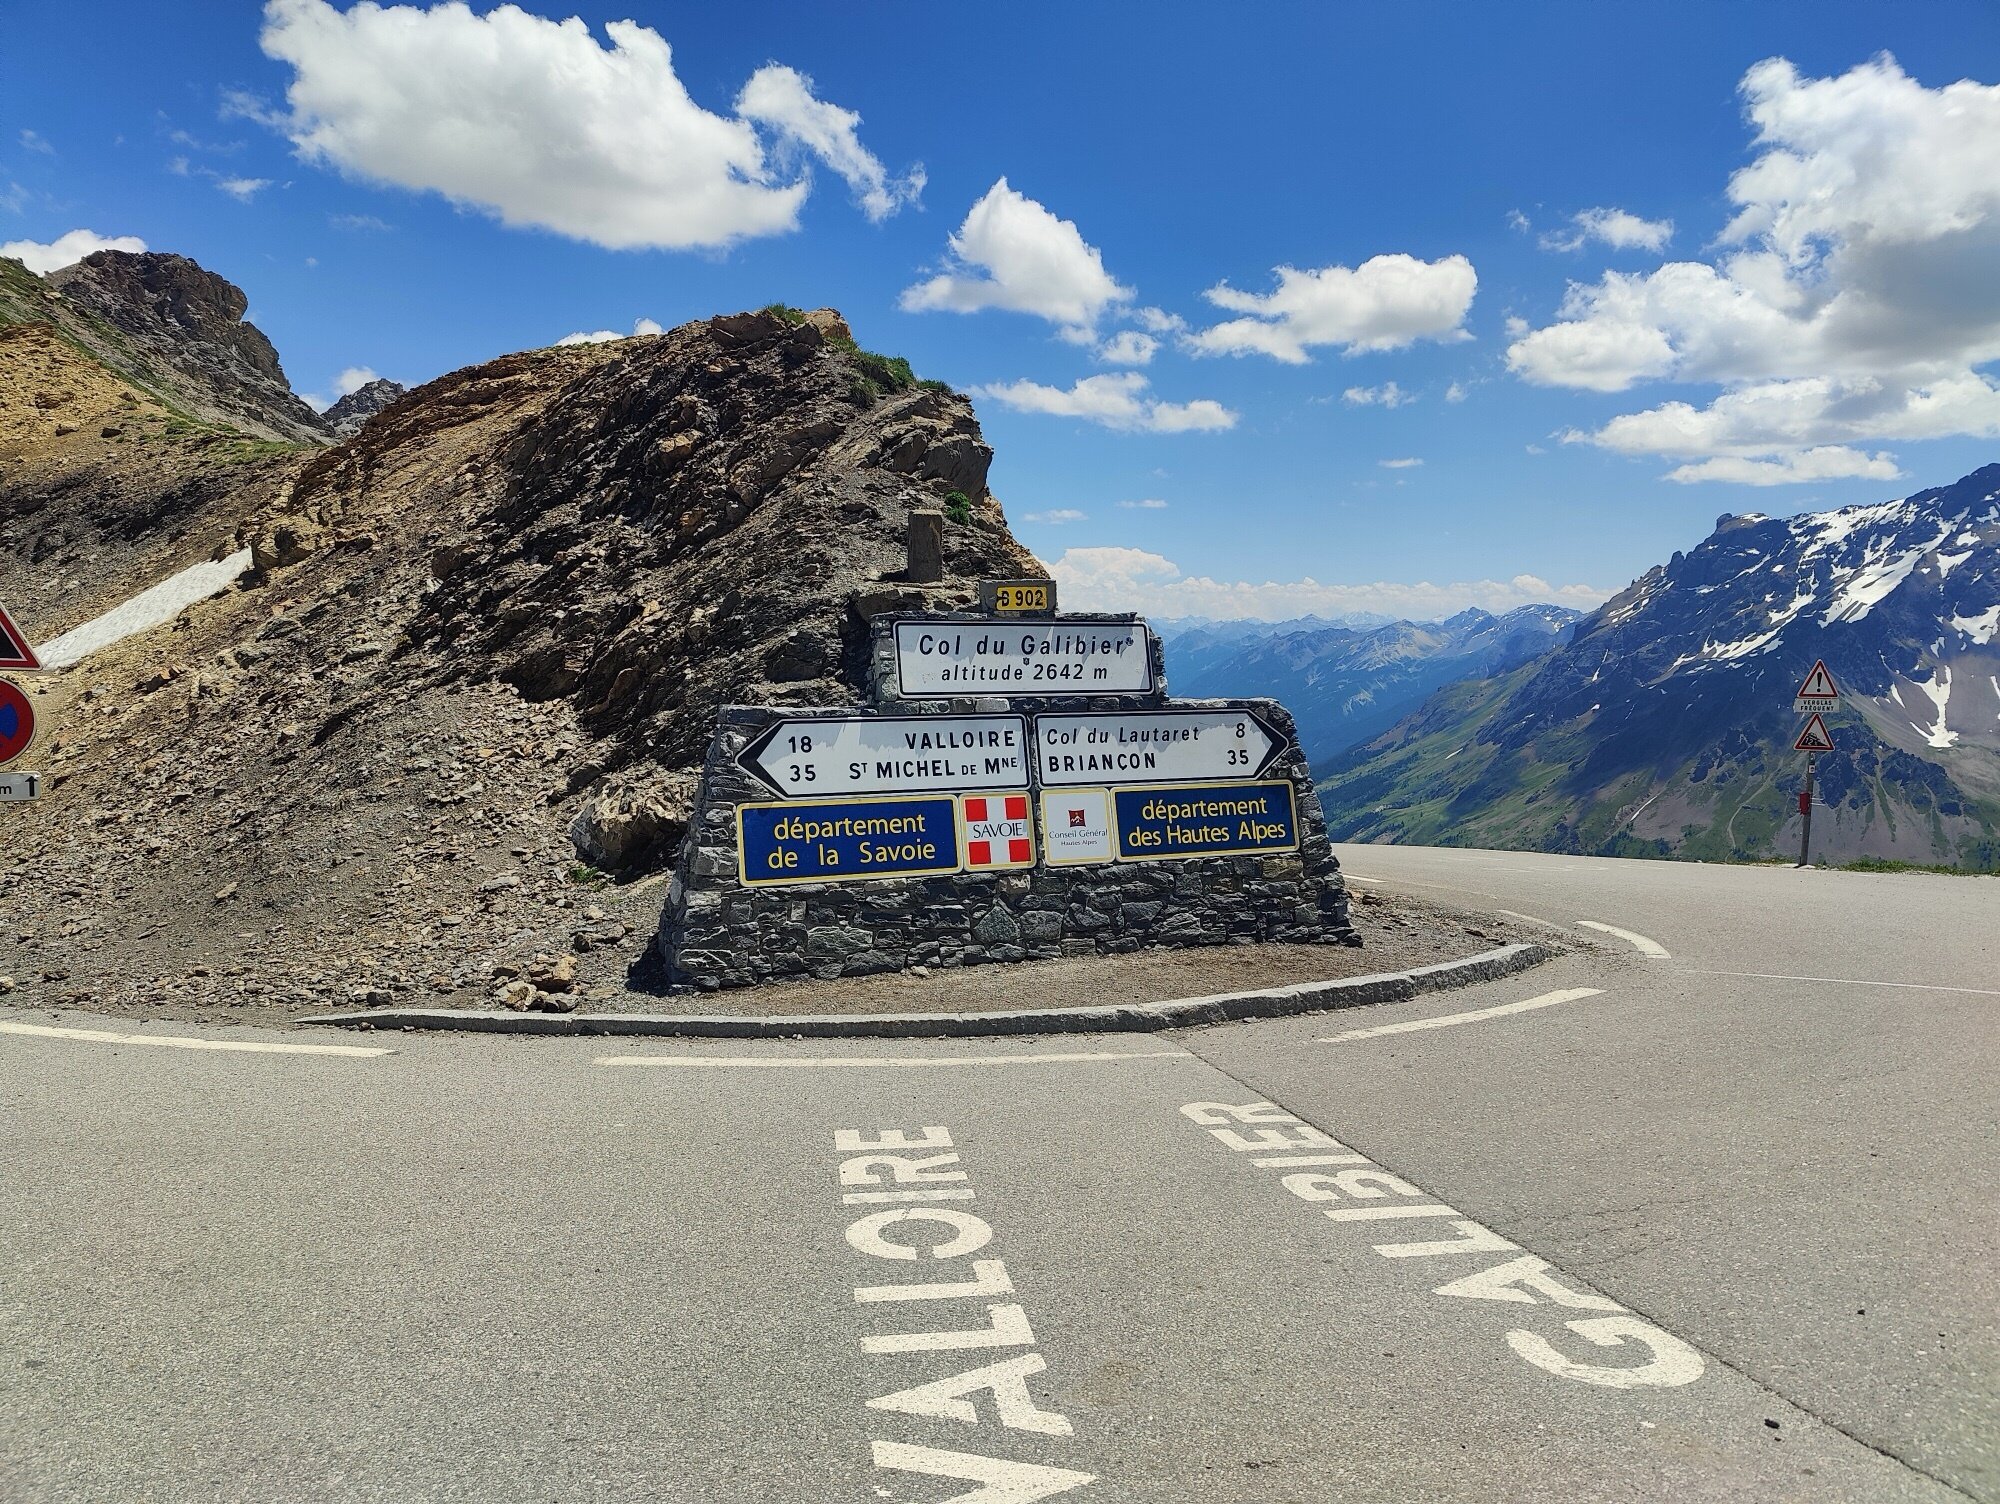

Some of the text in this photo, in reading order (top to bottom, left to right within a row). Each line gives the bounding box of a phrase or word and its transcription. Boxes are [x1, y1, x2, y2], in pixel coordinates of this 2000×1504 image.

[1001, 590, 1043, 607] D 902
[919, 634, 1123, 656] Col du Galibier
[941, 663, 1108, 681] altitude 2642 m
[788, 730, 1015, 753] 18 VALLOIRE
[1047, 723, 1246, 744] Col du Lautaret 8
[789, 764, 817, 782] 35
[876, 759, 955, 779] MICHEL
[961, 764, 977, 776] DE
[1049, 750, 1250, 772] BRIANÇON 35
[1142, 797, 1267, 824] département
[773, 813, 926, 843] département
[973, 822, 1024, 839] SAVOIE
[1049, 828, 1108, 839] Conseil Général
[1128, 820, 1286, 848] des Hautes Alpes
[767, 838, 936, 869] de la Savoie
[1179, 1101, 1706, 1390] GALIBIER
[834, 1125, 1099, 1504] VALLOIRE
